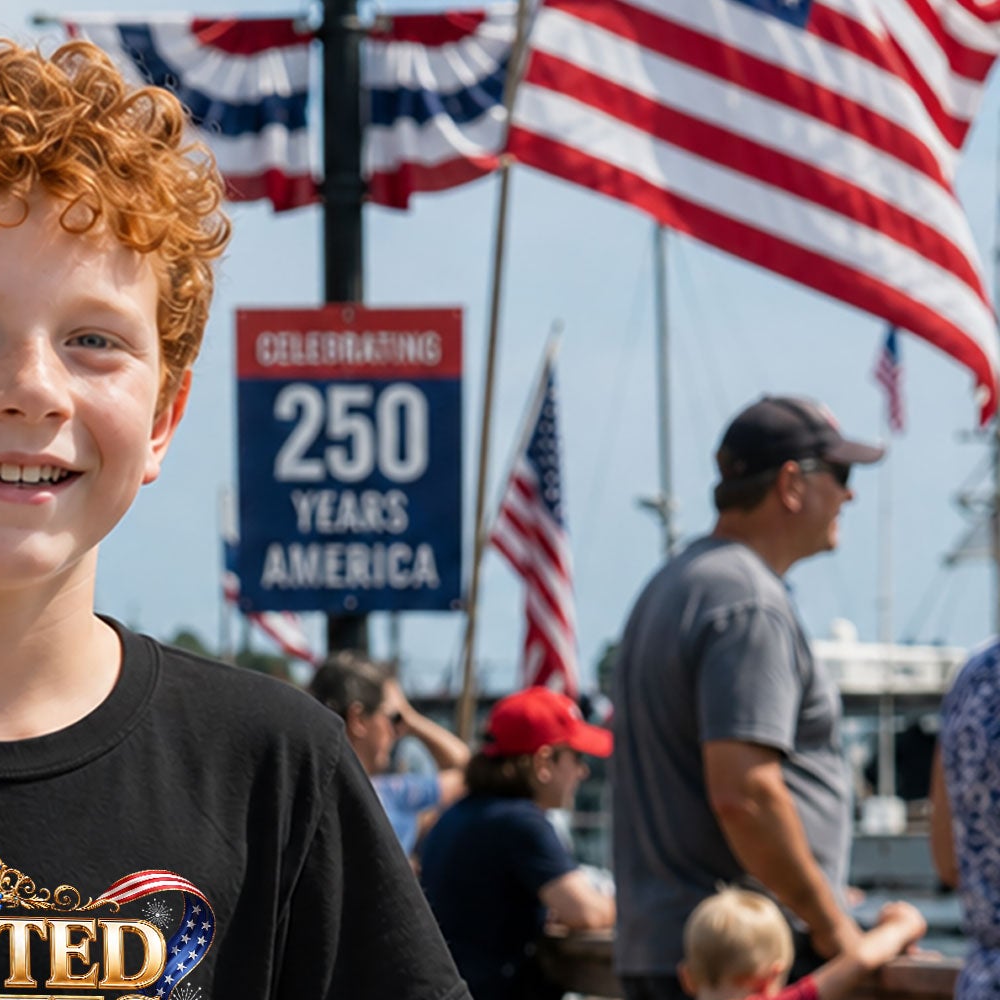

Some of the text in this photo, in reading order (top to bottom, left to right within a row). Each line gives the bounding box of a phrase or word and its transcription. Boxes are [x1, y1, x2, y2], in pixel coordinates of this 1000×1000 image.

[255, 331, 443, 367] CELEBRATING
[273, 382, 430, 483] 250
[291, 489, 409, 535] YEARS
[260, 543, 441, 590] AMERICA
